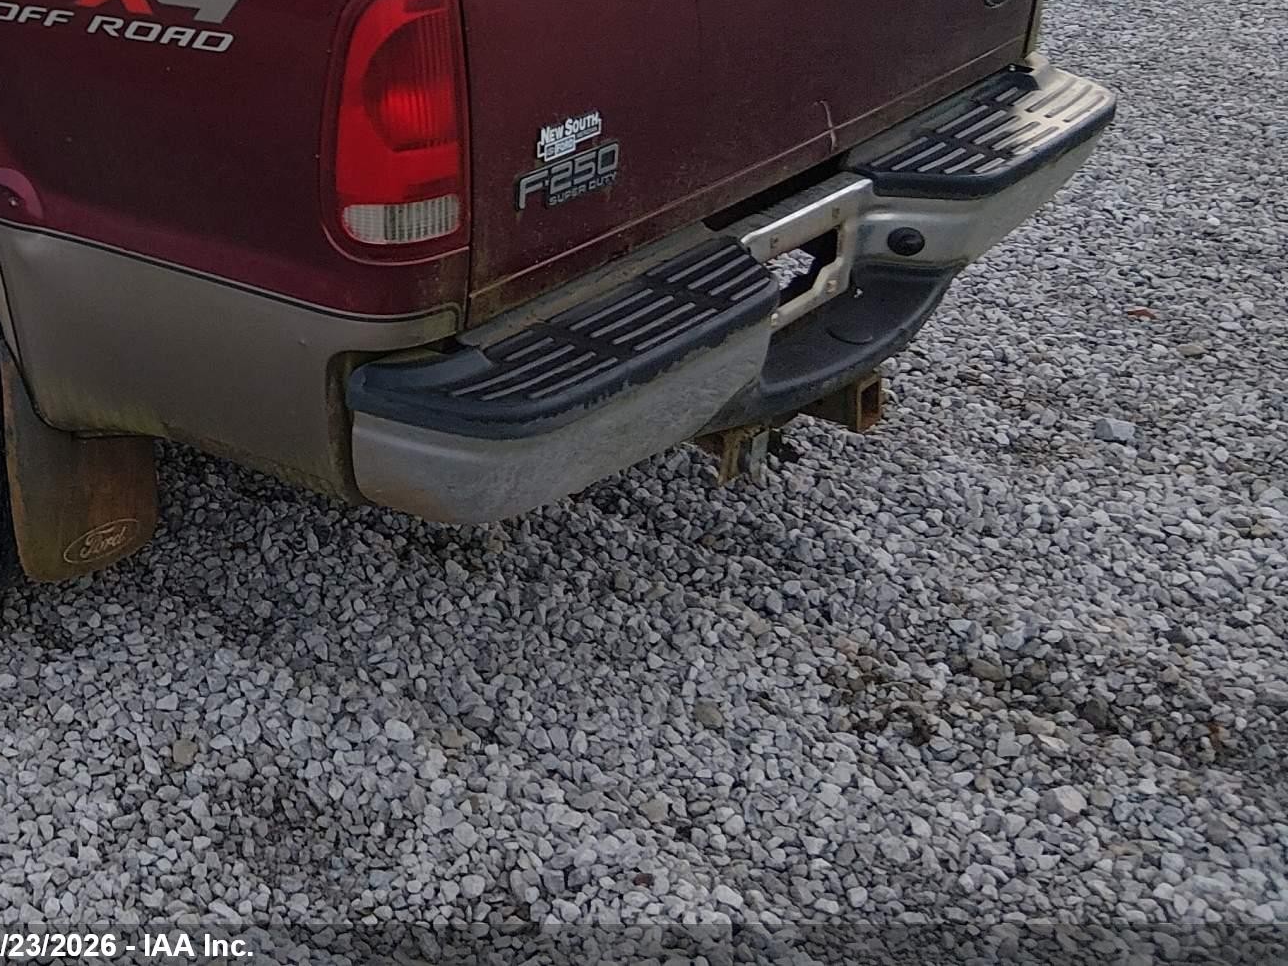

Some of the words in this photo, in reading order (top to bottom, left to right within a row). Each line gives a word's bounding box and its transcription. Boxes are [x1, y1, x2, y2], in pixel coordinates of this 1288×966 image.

[86, 15, 235, 53] ROAD
[541, 126, 563, 145] NEW
[565, 112, 599, 135] SOUTH
[549, 184, 587, 205] SUPER
[589, 172, 617, 189] DUTY
